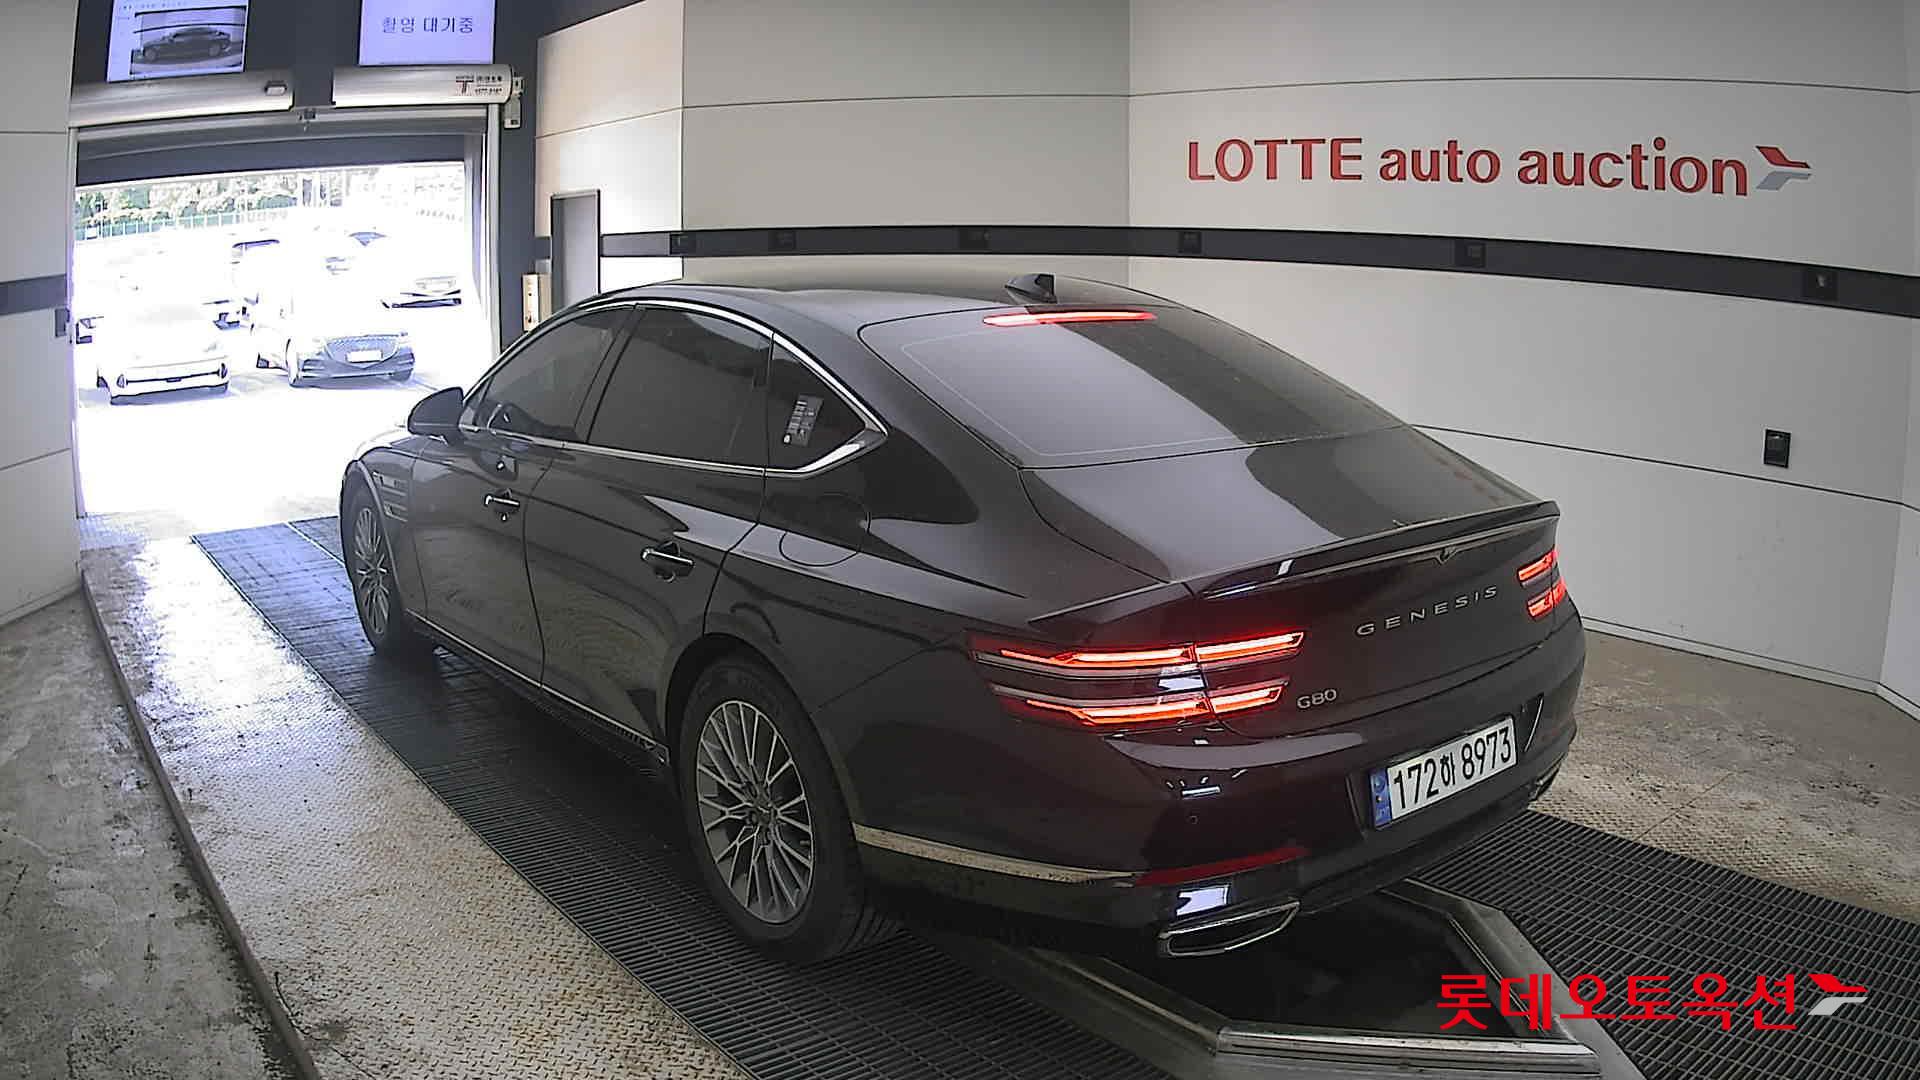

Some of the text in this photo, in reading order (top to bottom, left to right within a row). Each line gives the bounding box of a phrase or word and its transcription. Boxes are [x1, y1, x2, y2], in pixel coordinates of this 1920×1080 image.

[423, 15, 473, 34] 대기중
[1188, 137, 1748, 196] LOTTE auto auction
[1356, 585, 1498, 636] GENESIS
[1296, 688, 1337, 710] G80
[1461, 726, 1511, 780] 8973
